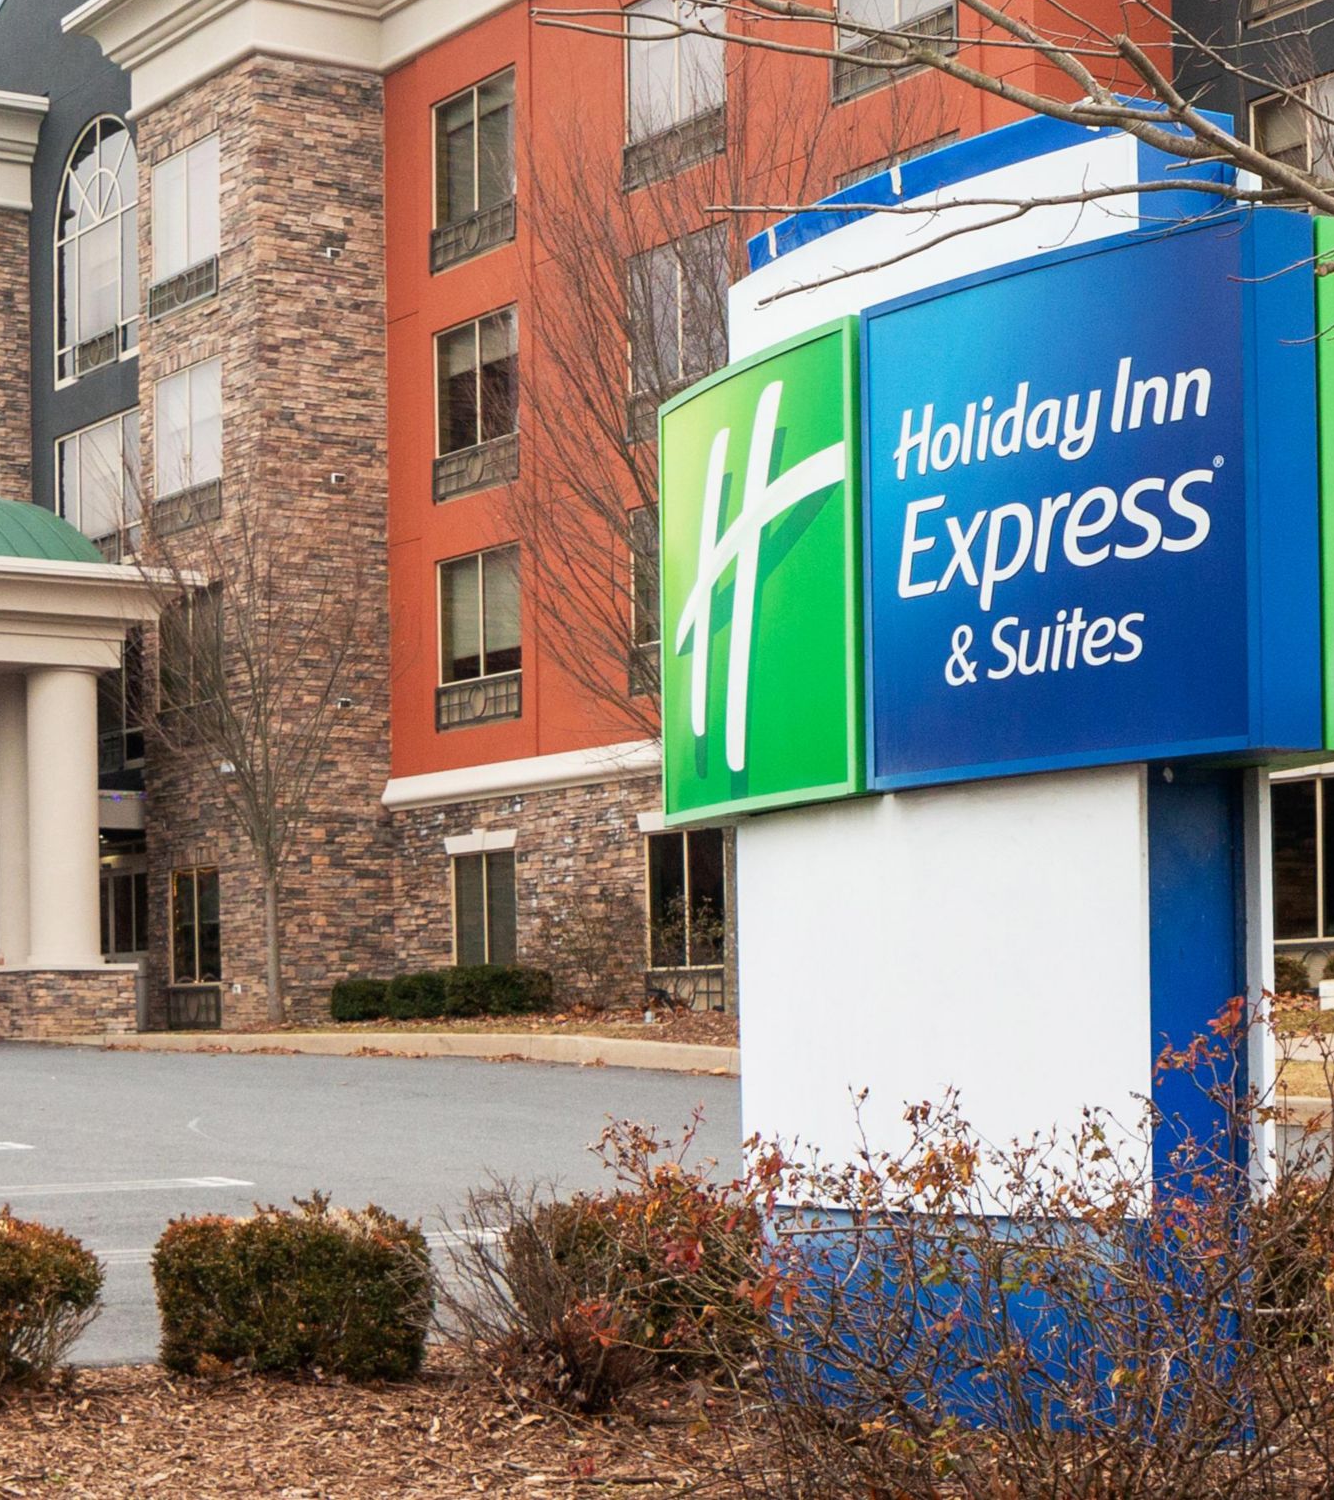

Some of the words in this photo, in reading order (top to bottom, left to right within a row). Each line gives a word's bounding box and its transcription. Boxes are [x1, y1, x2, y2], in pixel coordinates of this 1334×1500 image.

[893, 380, 1102, 480] Holiday
[1110, 356, 1212, 434] Inn
[944, 624, 978, 687] &
[987, 607, 1145, 681] Suites
